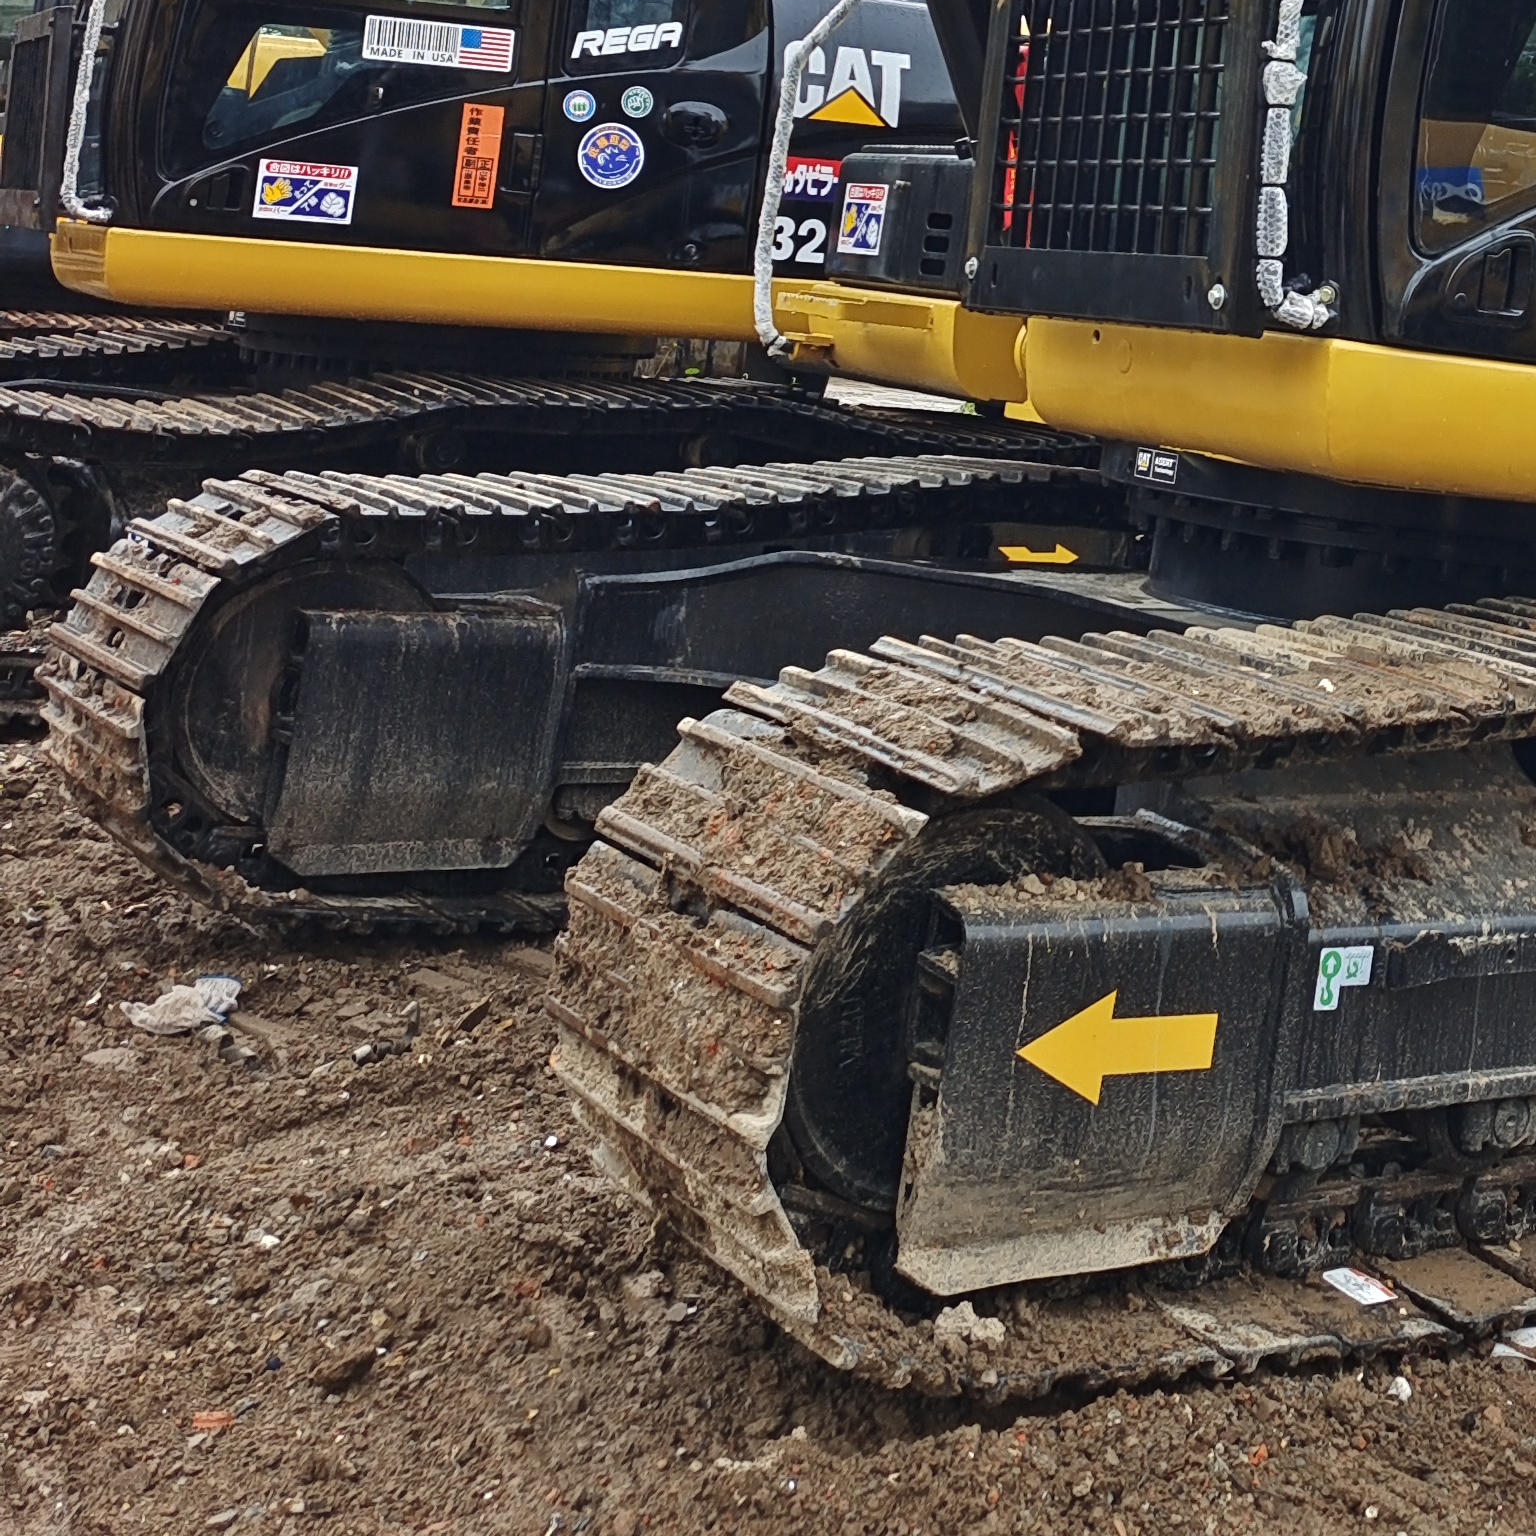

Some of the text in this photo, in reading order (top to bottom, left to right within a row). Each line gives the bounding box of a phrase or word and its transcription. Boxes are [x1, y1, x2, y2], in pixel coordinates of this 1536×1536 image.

[369, 46, 454, 64] MADE IN USA
[571, 22, 683, 59] REGA
[784, 40, 911, 128] CAT
